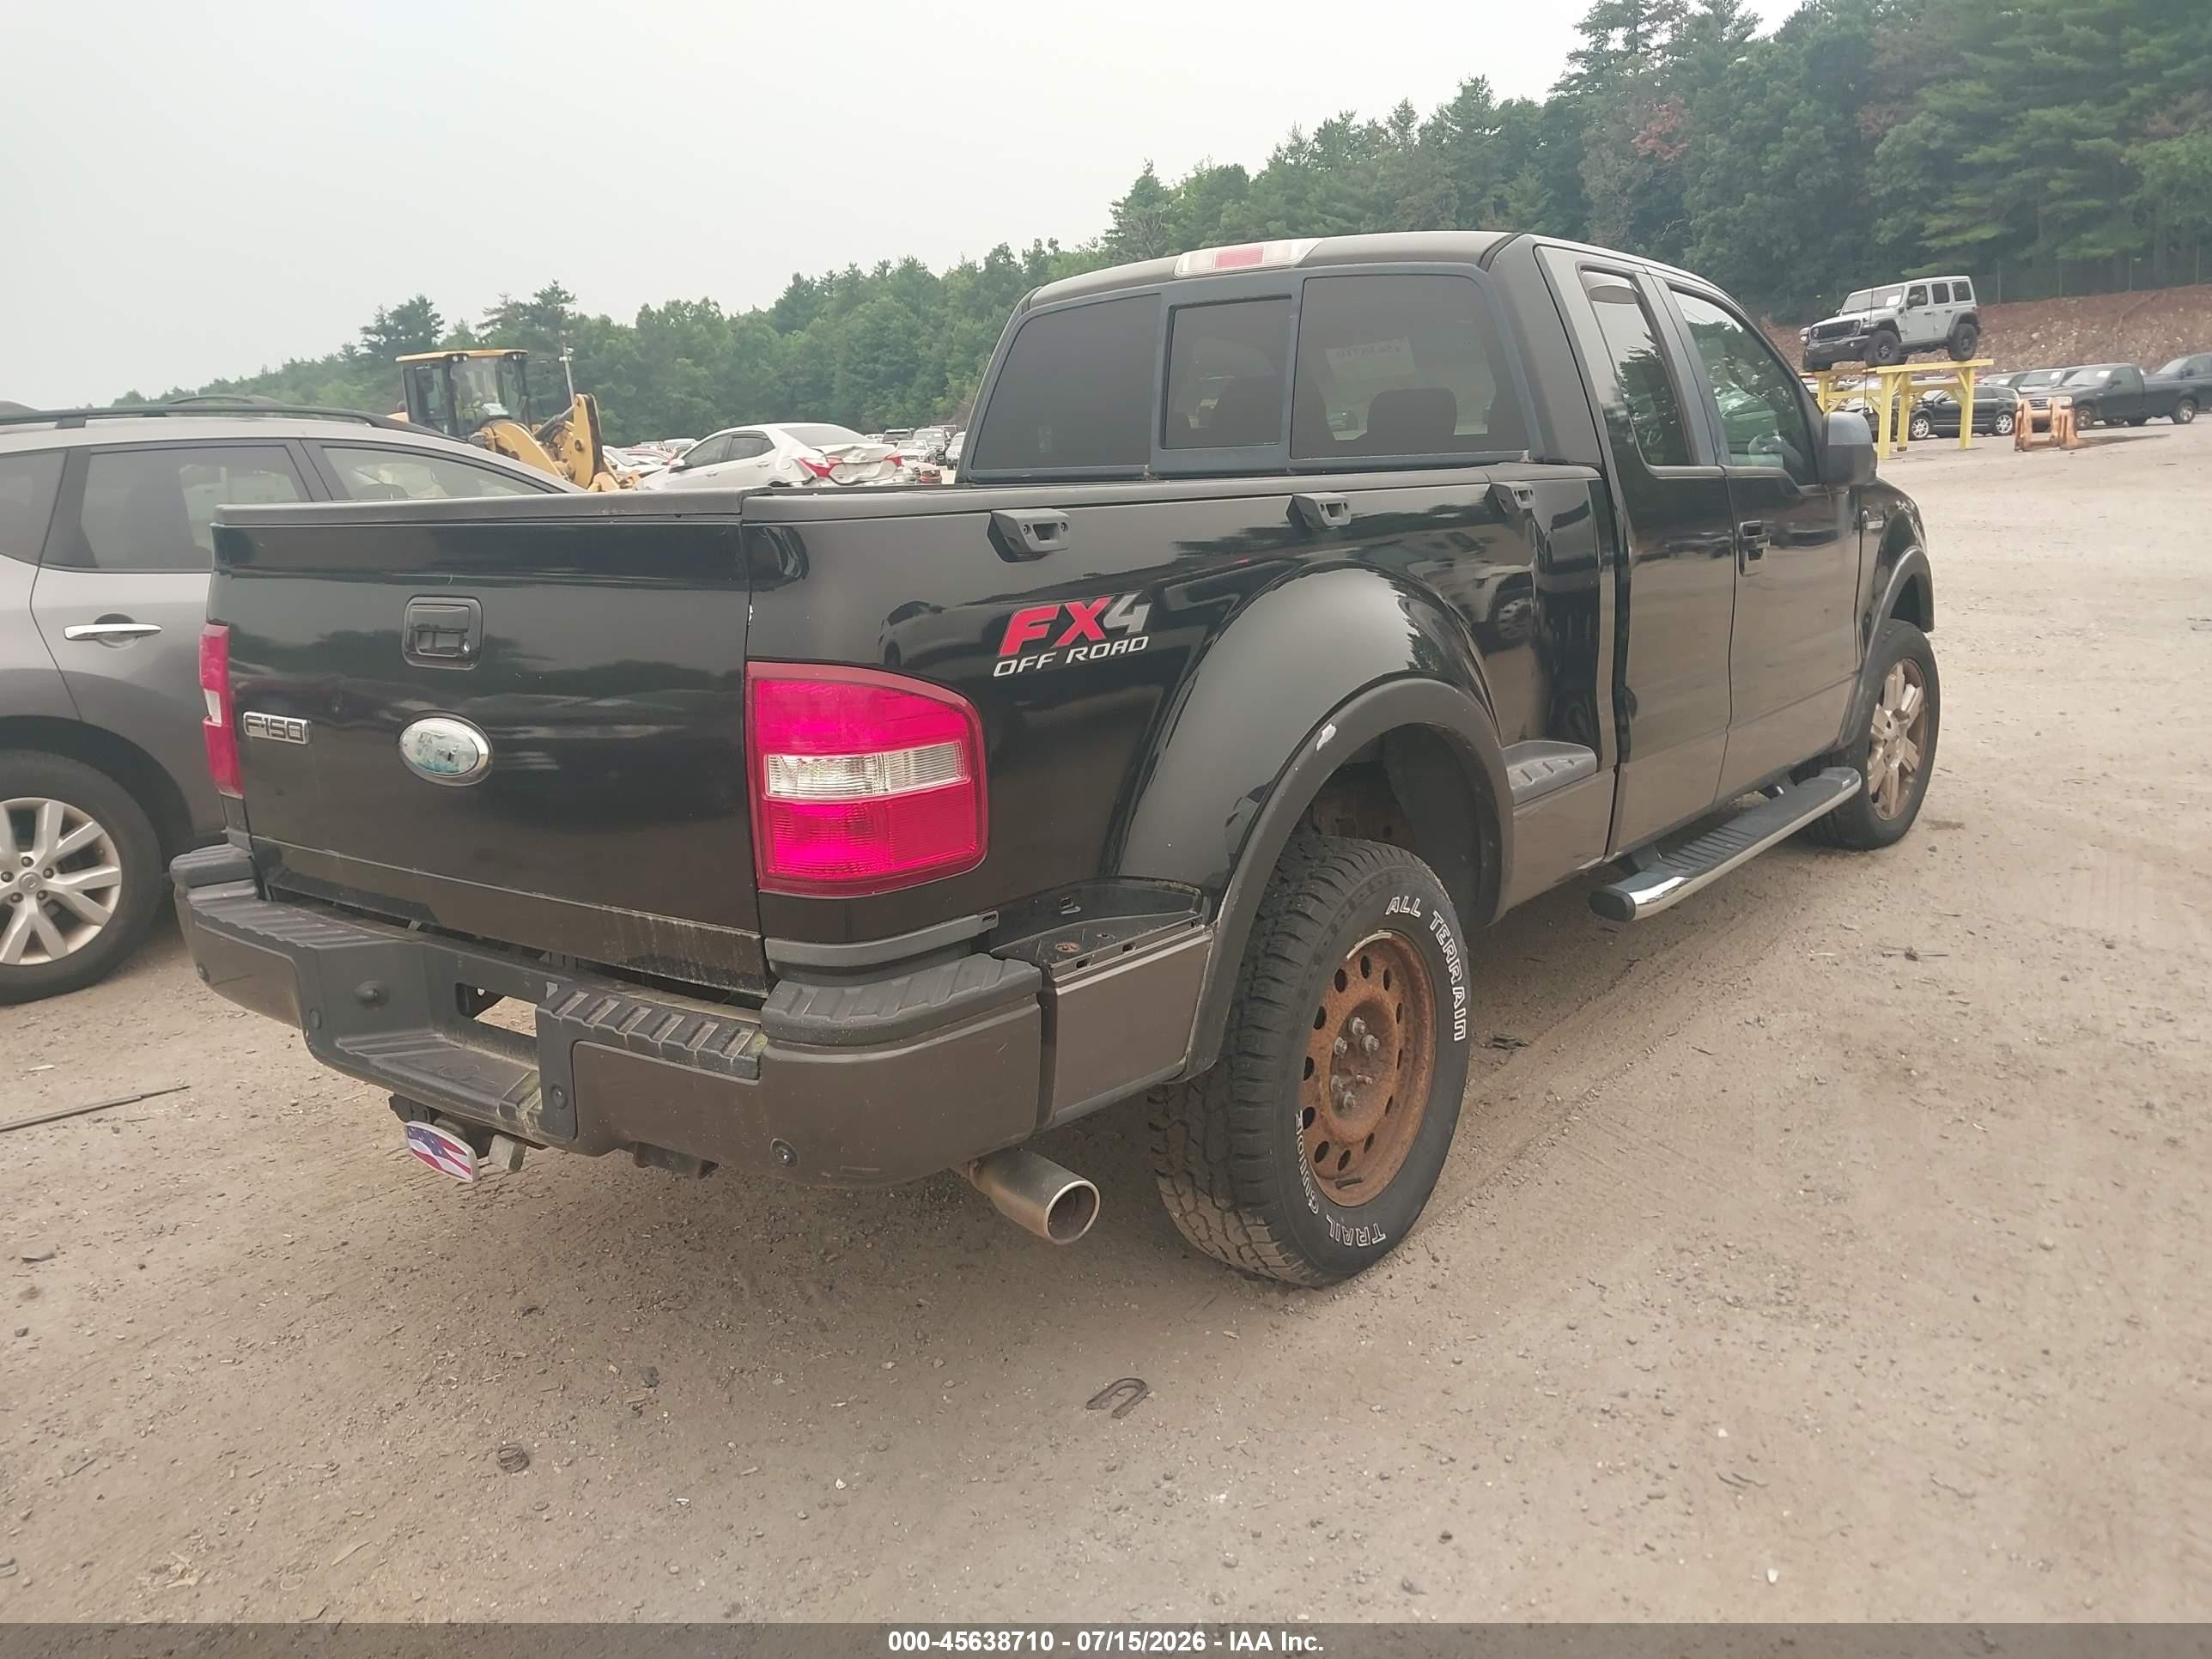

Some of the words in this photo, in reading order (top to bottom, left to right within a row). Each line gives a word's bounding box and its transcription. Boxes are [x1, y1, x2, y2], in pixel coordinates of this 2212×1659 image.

[993, 651, 1057, 678] OFF
[1065, 635, 1150, 665] ROAD
[997, 591, 1152, 658] FX4
[1385, 896, 1421, 918] ALL
[1429, 910, 1467, 1042] TERRAIN
[1296, 1109, 1320, 1214] GUIDE
[1326, 1213, 1387, 1247] TRAIL
